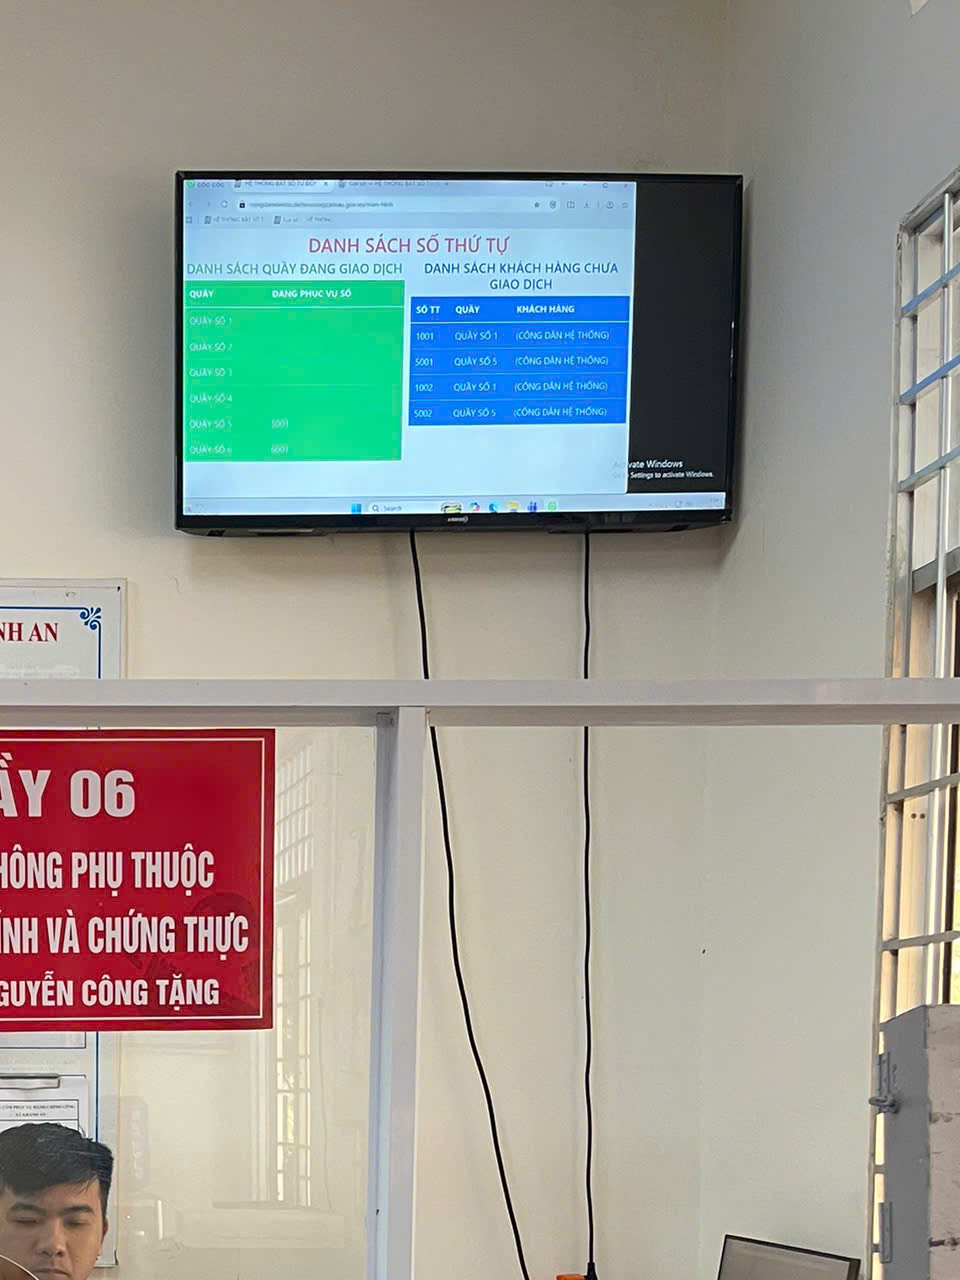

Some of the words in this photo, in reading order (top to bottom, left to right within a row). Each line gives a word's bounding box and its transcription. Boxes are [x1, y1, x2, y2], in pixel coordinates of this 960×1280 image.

[309, 238, 360, 253] DANH
[365, 233, 411, 253] SÁCH
[416, 233, 439, 253] SỐ
[445, 234, 482, 253] THỨ
[486, 235, 511, 255] TỰ
[187, 264, 223, 275] DANH
[227, 261, 259, 275] SÁCH
[262, 261, 297, 276] QUẦY
[300, 263, 336, 275] ĐANG
[339, 263, 370, 275] GIAO
[373, 263, 403, 277] DỊCH
[424, 262, 460, 274] DANH
[463, 260, 496, 274] SÁCH
[499, 260, 542, 274] KHÁCH
[545, 260, 581, 274] HÀNG
[584, 261, 619, 274] CHƯA
[490, 279, 520, 291] GIAO
[523, 279, 553, 293] DỊCH
[430, 306, 441, 314] TT
[455, 303, 480, 315] QUẦY
[517, 304, 547, 314] KHÁCH
[549, 304, 576, 314] HÀNG
[416, 332, 434, 340] 1001
[415, 358, 433, 366] 5001
[414, 384, 432, 392] 1002
[414, 409, 432, 417] 5002
[646, 460, 683, 468] Windows
[29, 621, 59, 643] AN
[71, 768, 137, 818] 06
[71, 851, 124, 897] PHỤ
[131, 843, 214, 897] THUỘC
[46, 908, 81, 954] VÀ
[87, 907, 174, 954] CHỨNG
[183, 913, 249, 961] THỰC
[81, 974, 148, 1006] CÔNG
[155, 973, 219, 1011] TẶNG
